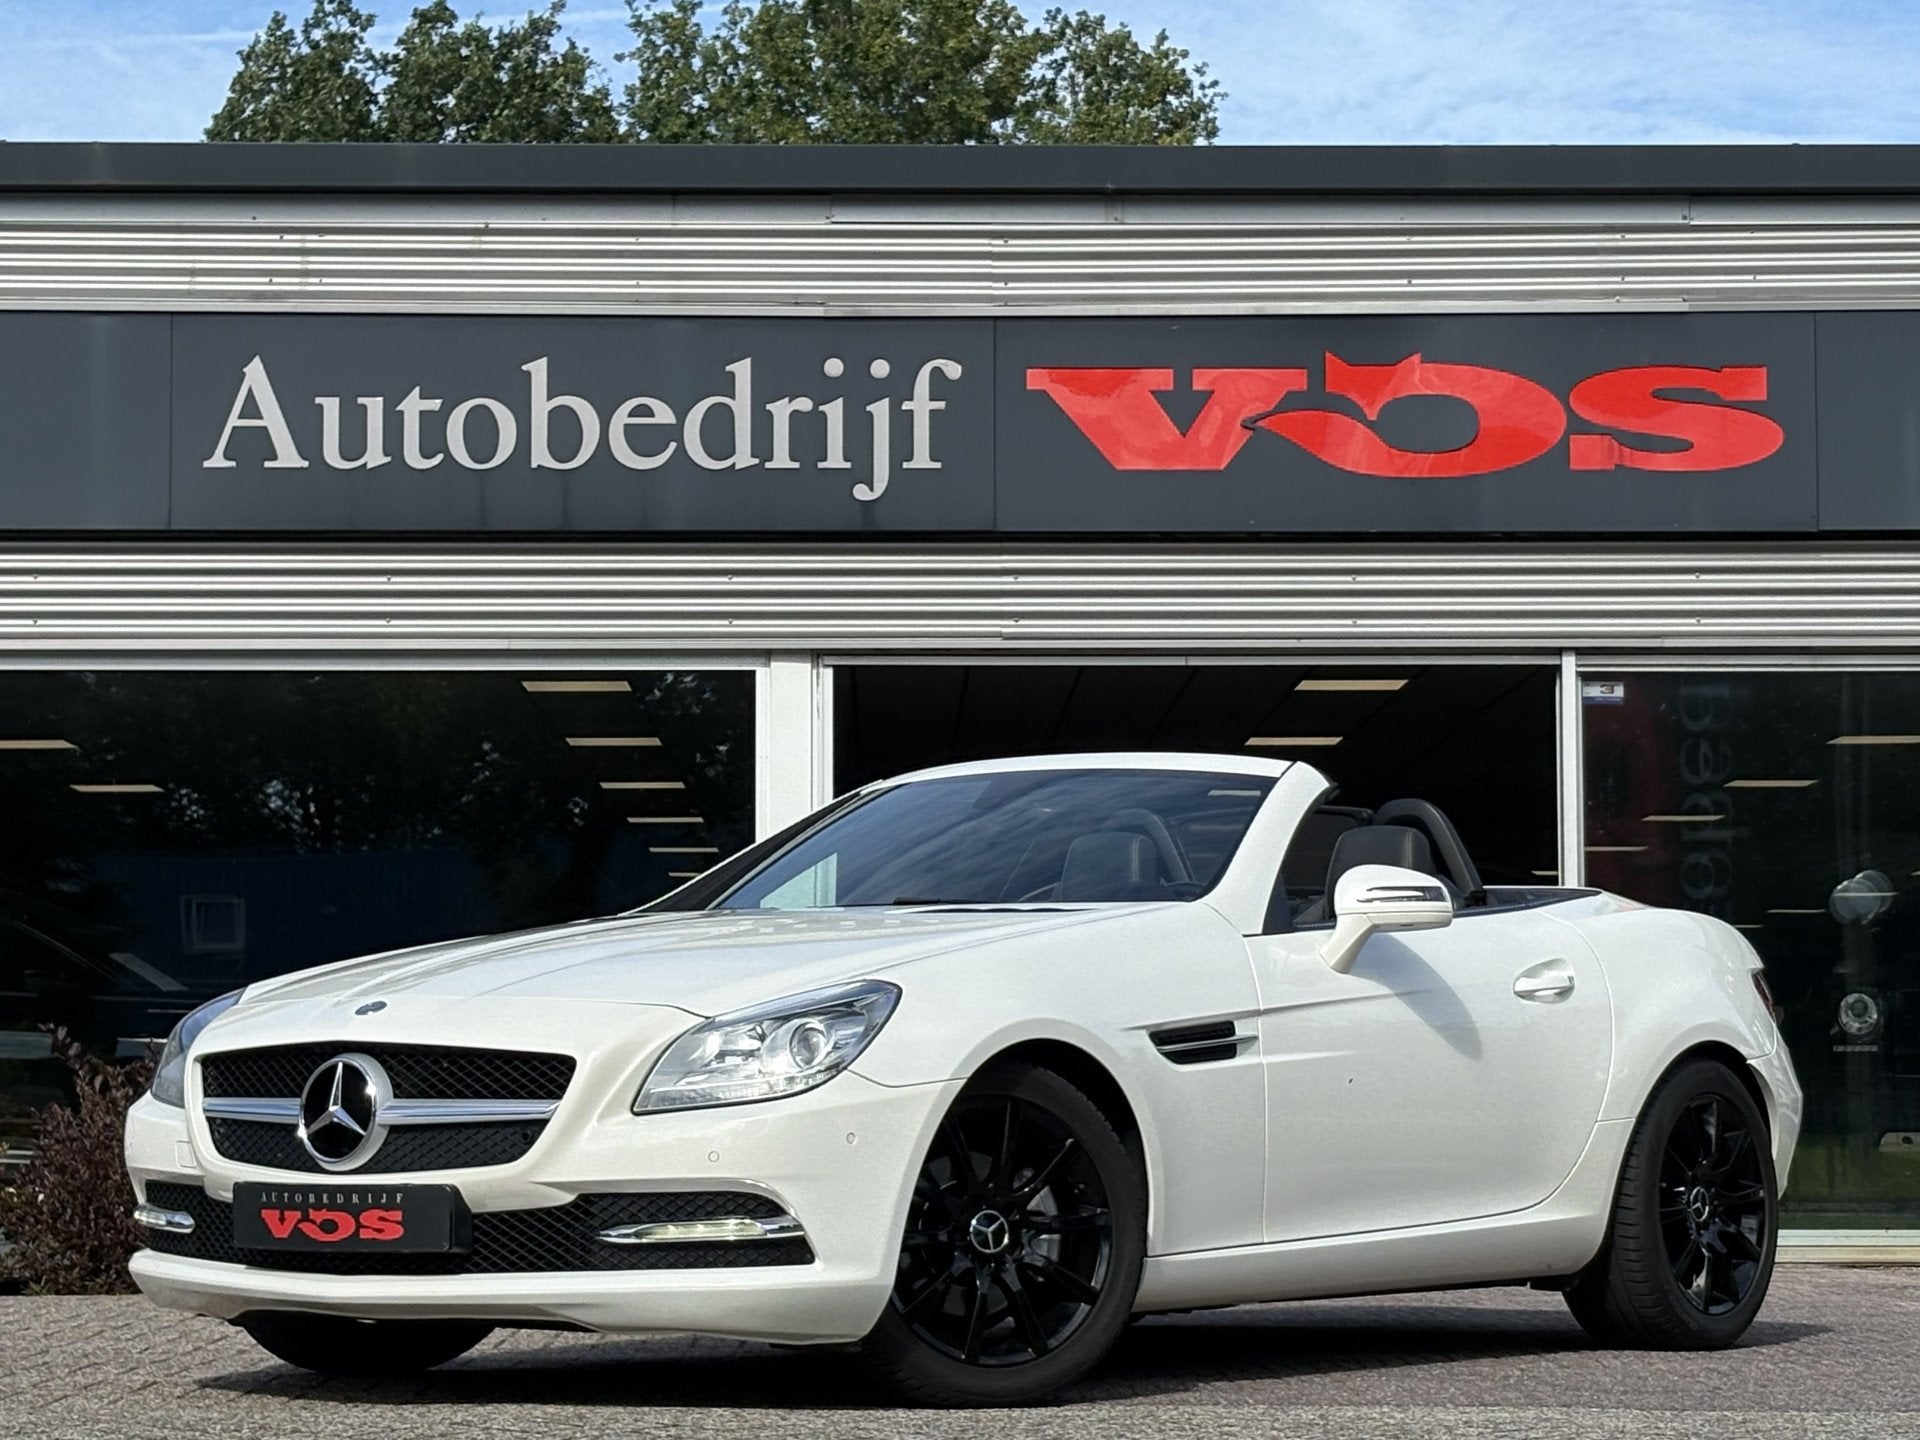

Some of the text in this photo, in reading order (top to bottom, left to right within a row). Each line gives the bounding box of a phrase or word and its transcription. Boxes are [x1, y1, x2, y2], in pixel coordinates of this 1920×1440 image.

[202, 352, 1785, 501] Autobedrijf VOS
[260, 1191, 403, 1204] AUTOBEDRIJF
[261, 1207, 405, 1242] VOS
